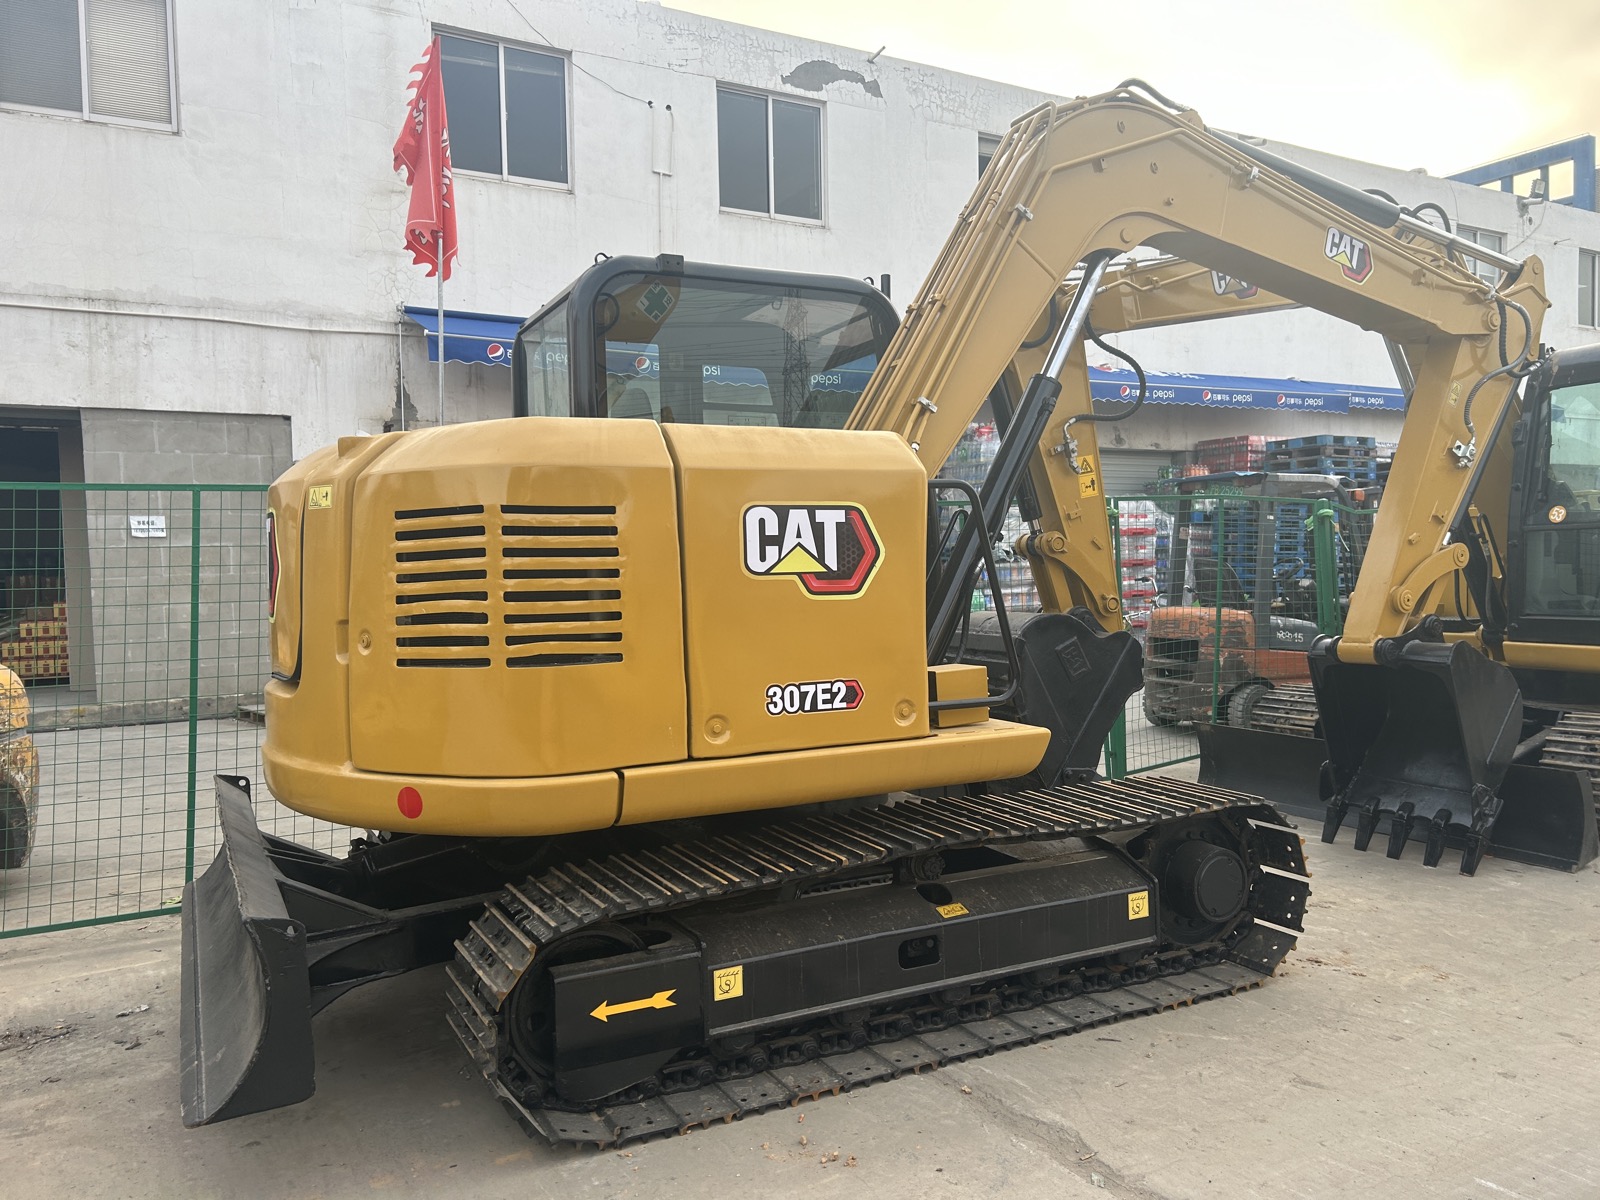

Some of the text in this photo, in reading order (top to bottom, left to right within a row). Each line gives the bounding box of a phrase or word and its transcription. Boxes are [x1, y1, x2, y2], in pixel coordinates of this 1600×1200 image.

[1325, 227, 1364, 270] CAT
[703, 364, 721, 377] psi
[811, 373, 842, 386] pepsi
[1153, 389, 1175, 400] pepsi
[1232, 393, 1253, 404] pepsi
[1367, 396, 1385, 406] pepsi
[1304, 397, 1324, 408] pepsi
[1550, 507, 1565, 521] 53
[745, 506, 846, 573] CAT
[767, 681, 848, 714] 307E2
